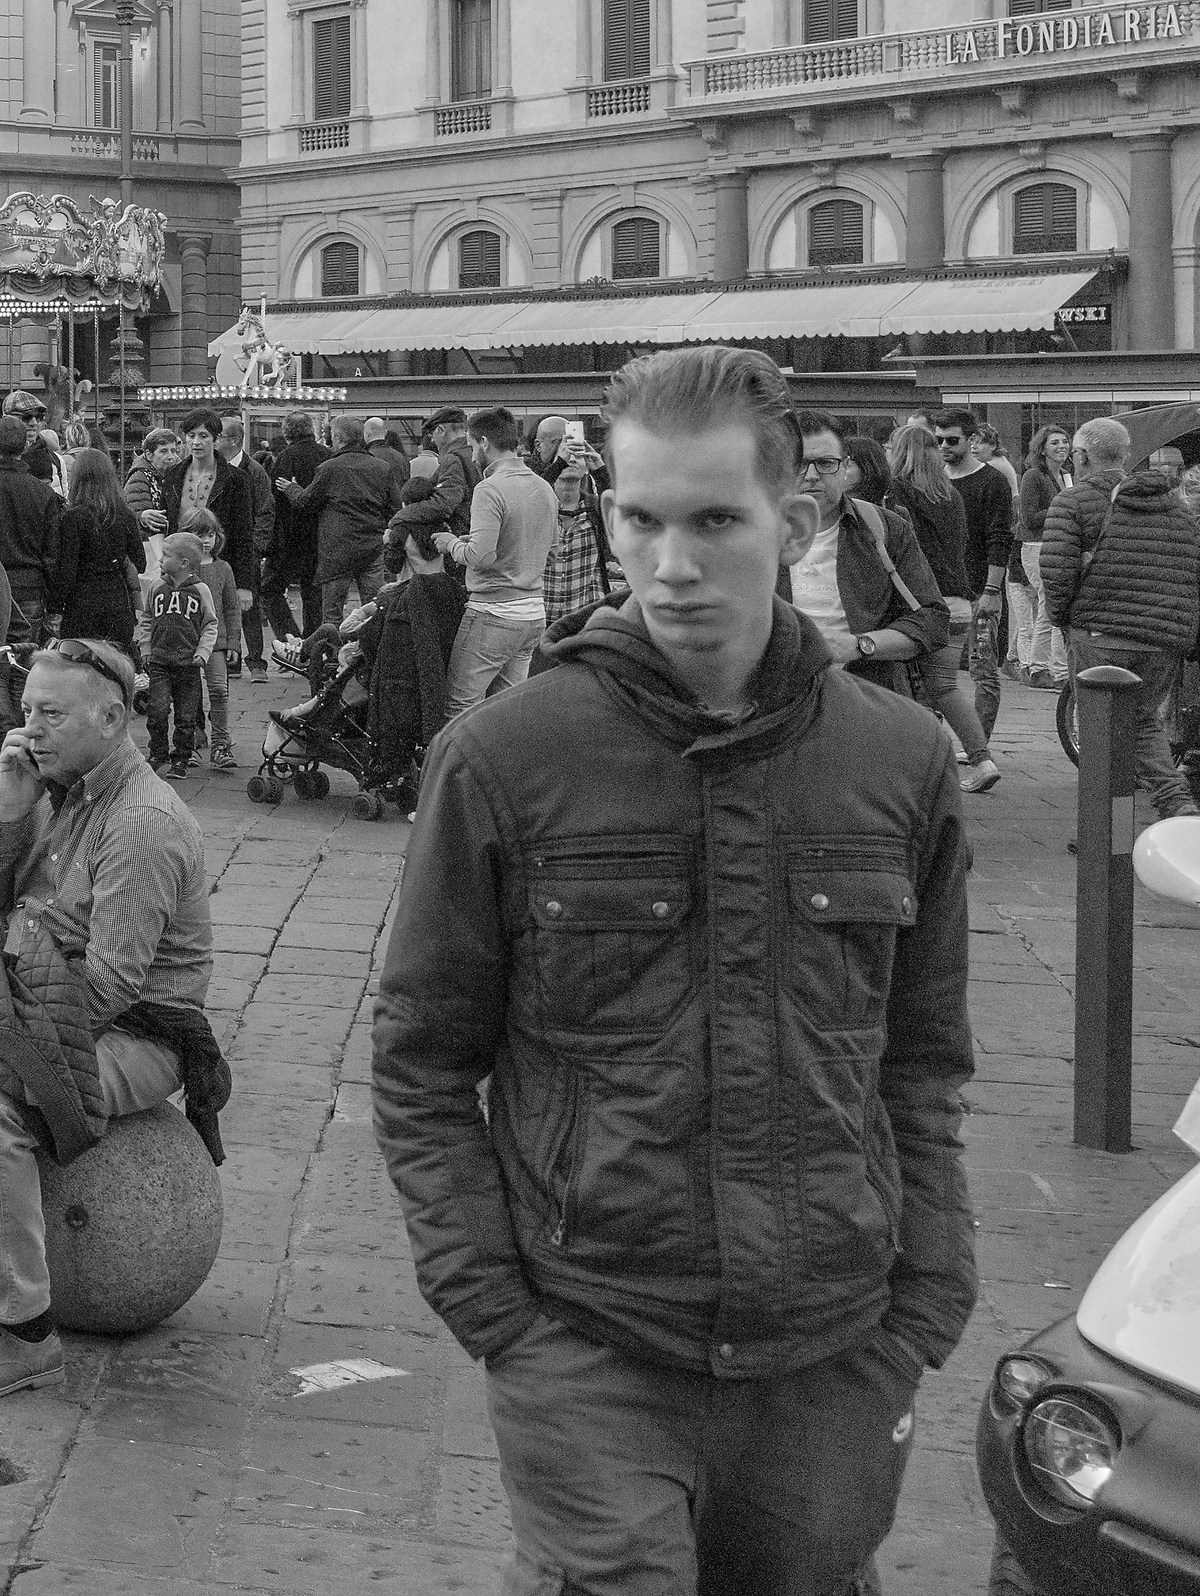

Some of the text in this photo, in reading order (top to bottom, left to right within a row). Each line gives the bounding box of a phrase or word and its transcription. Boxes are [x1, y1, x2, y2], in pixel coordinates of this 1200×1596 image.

[945, 4, 1183, 65] LA FONDIARIA
[1058, 307, 1107, 322] WSKI
[154, 591, 199, 620] GAP
